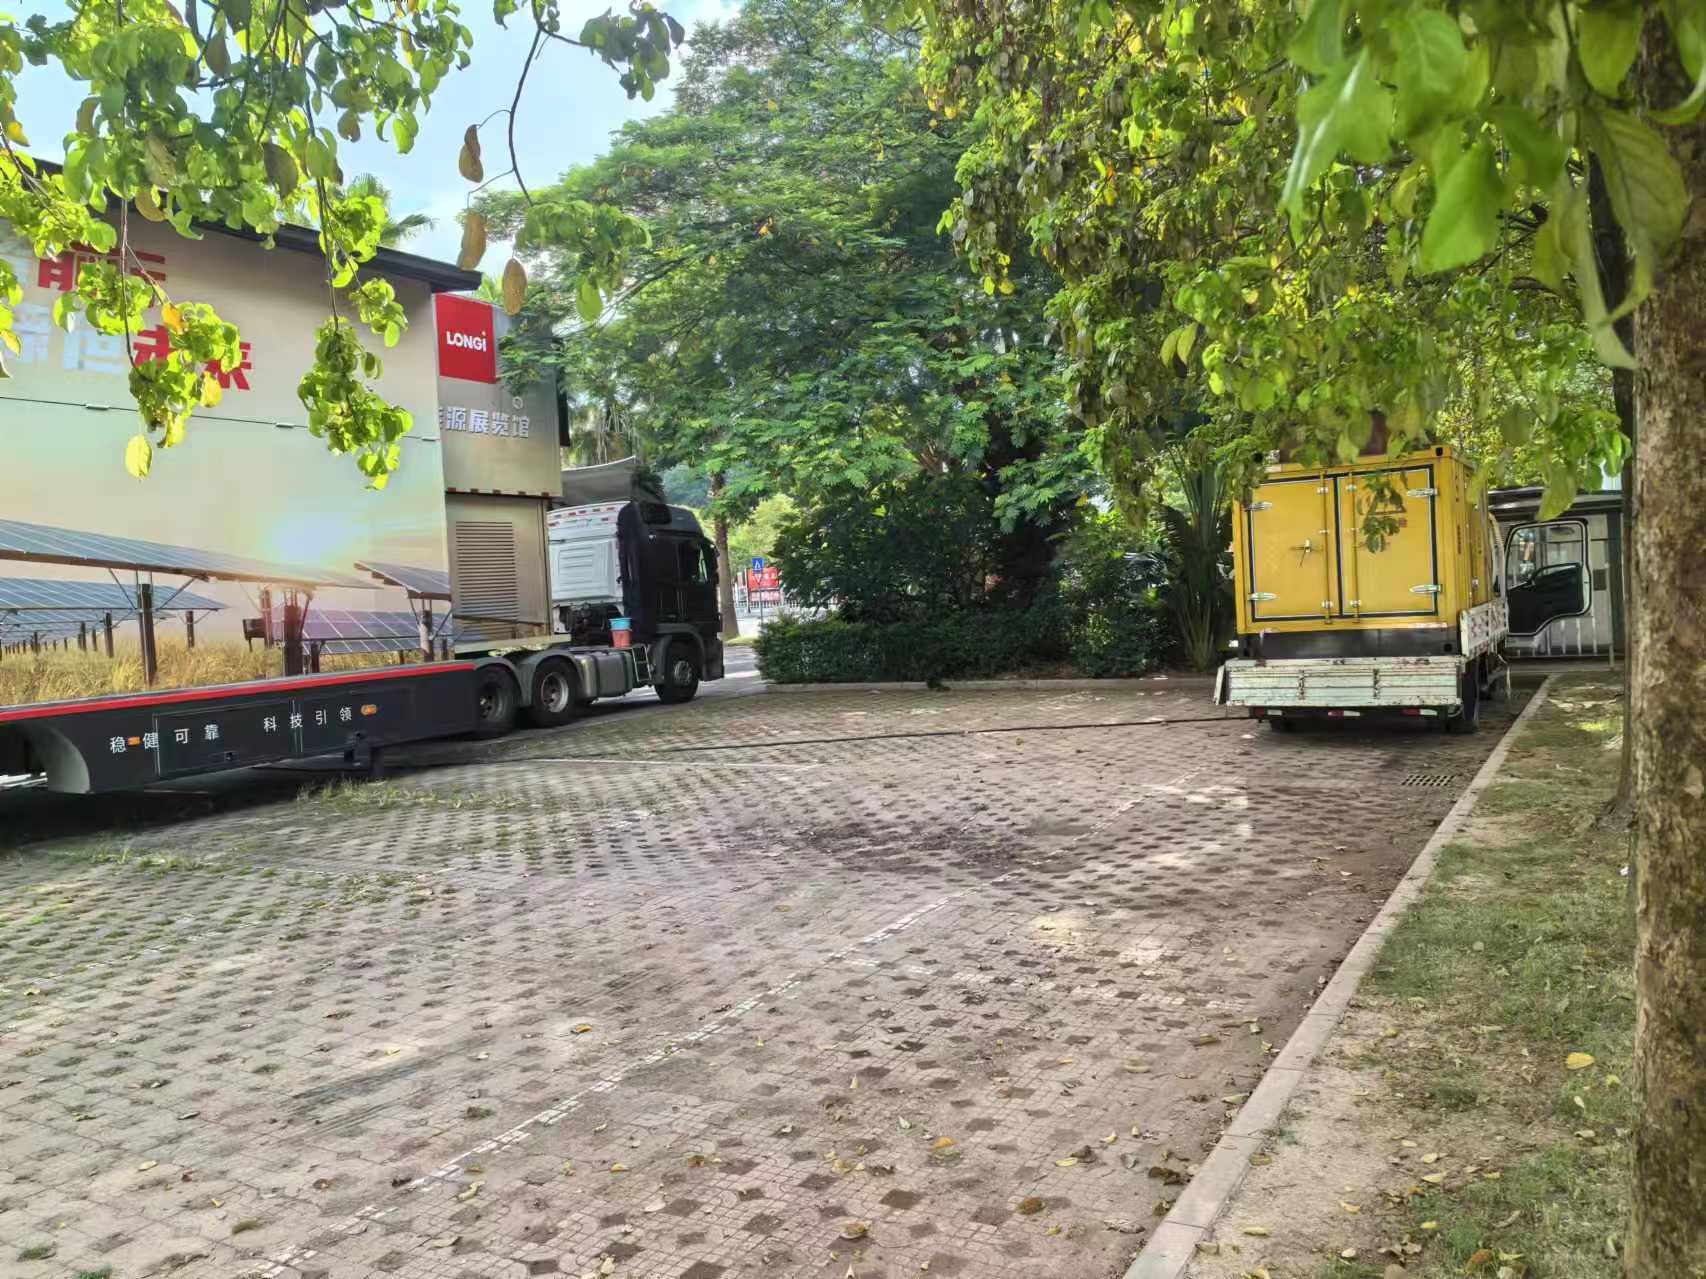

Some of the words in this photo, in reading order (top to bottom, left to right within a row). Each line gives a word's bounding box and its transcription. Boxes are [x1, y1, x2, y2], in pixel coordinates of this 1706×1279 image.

[110, 724, 219, 754] 稳健可靠
[263, 707, 352, 733] 科技引领
